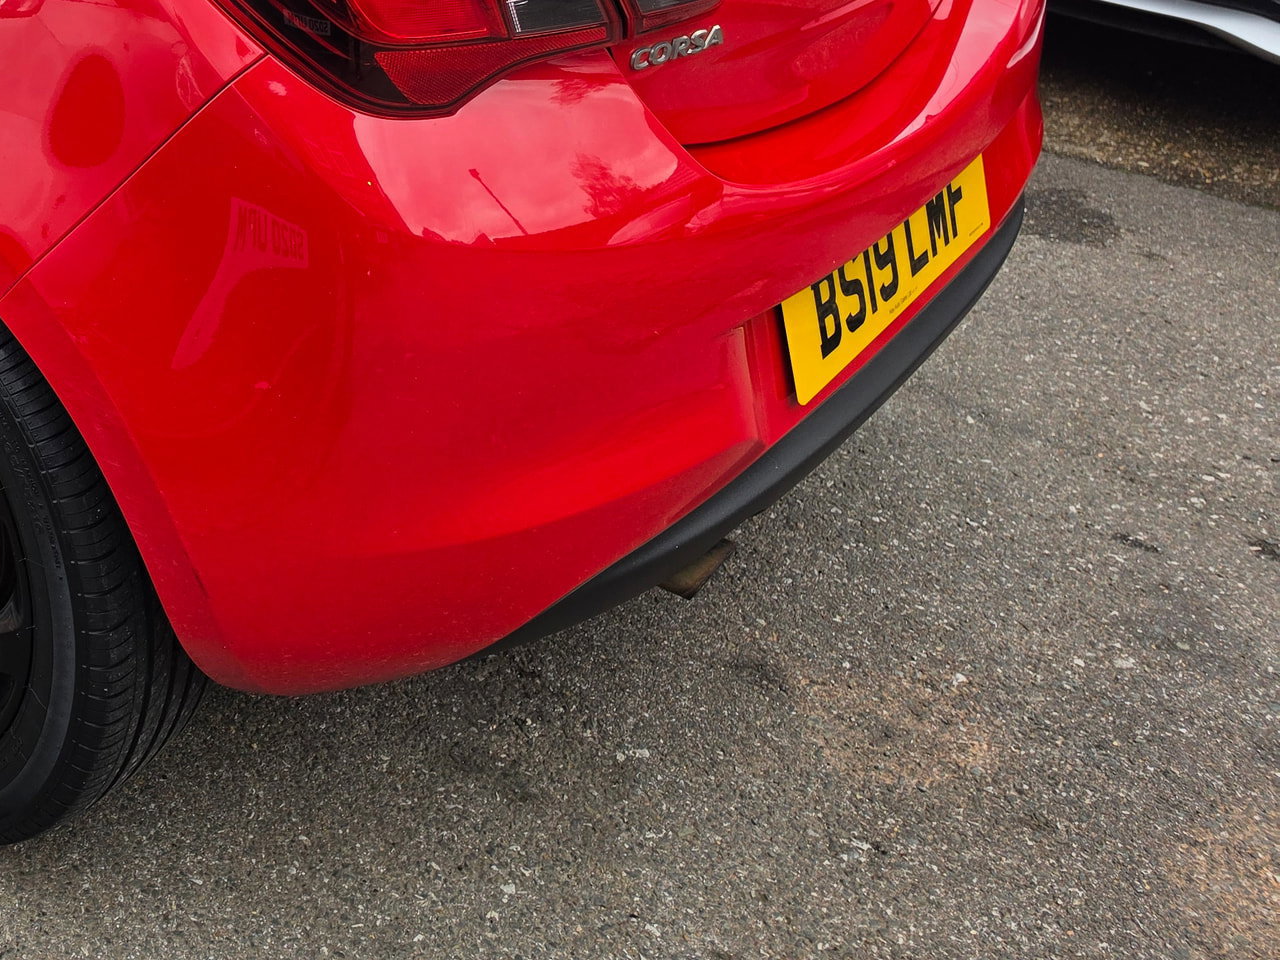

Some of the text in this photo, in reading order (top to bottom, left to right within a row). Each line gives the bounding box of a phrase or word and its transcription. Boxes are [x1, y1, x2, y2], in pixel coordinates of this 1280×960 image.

[631, 25, 723, 70] CORSA
[811, 183, 963, 360] BS19 LMF
